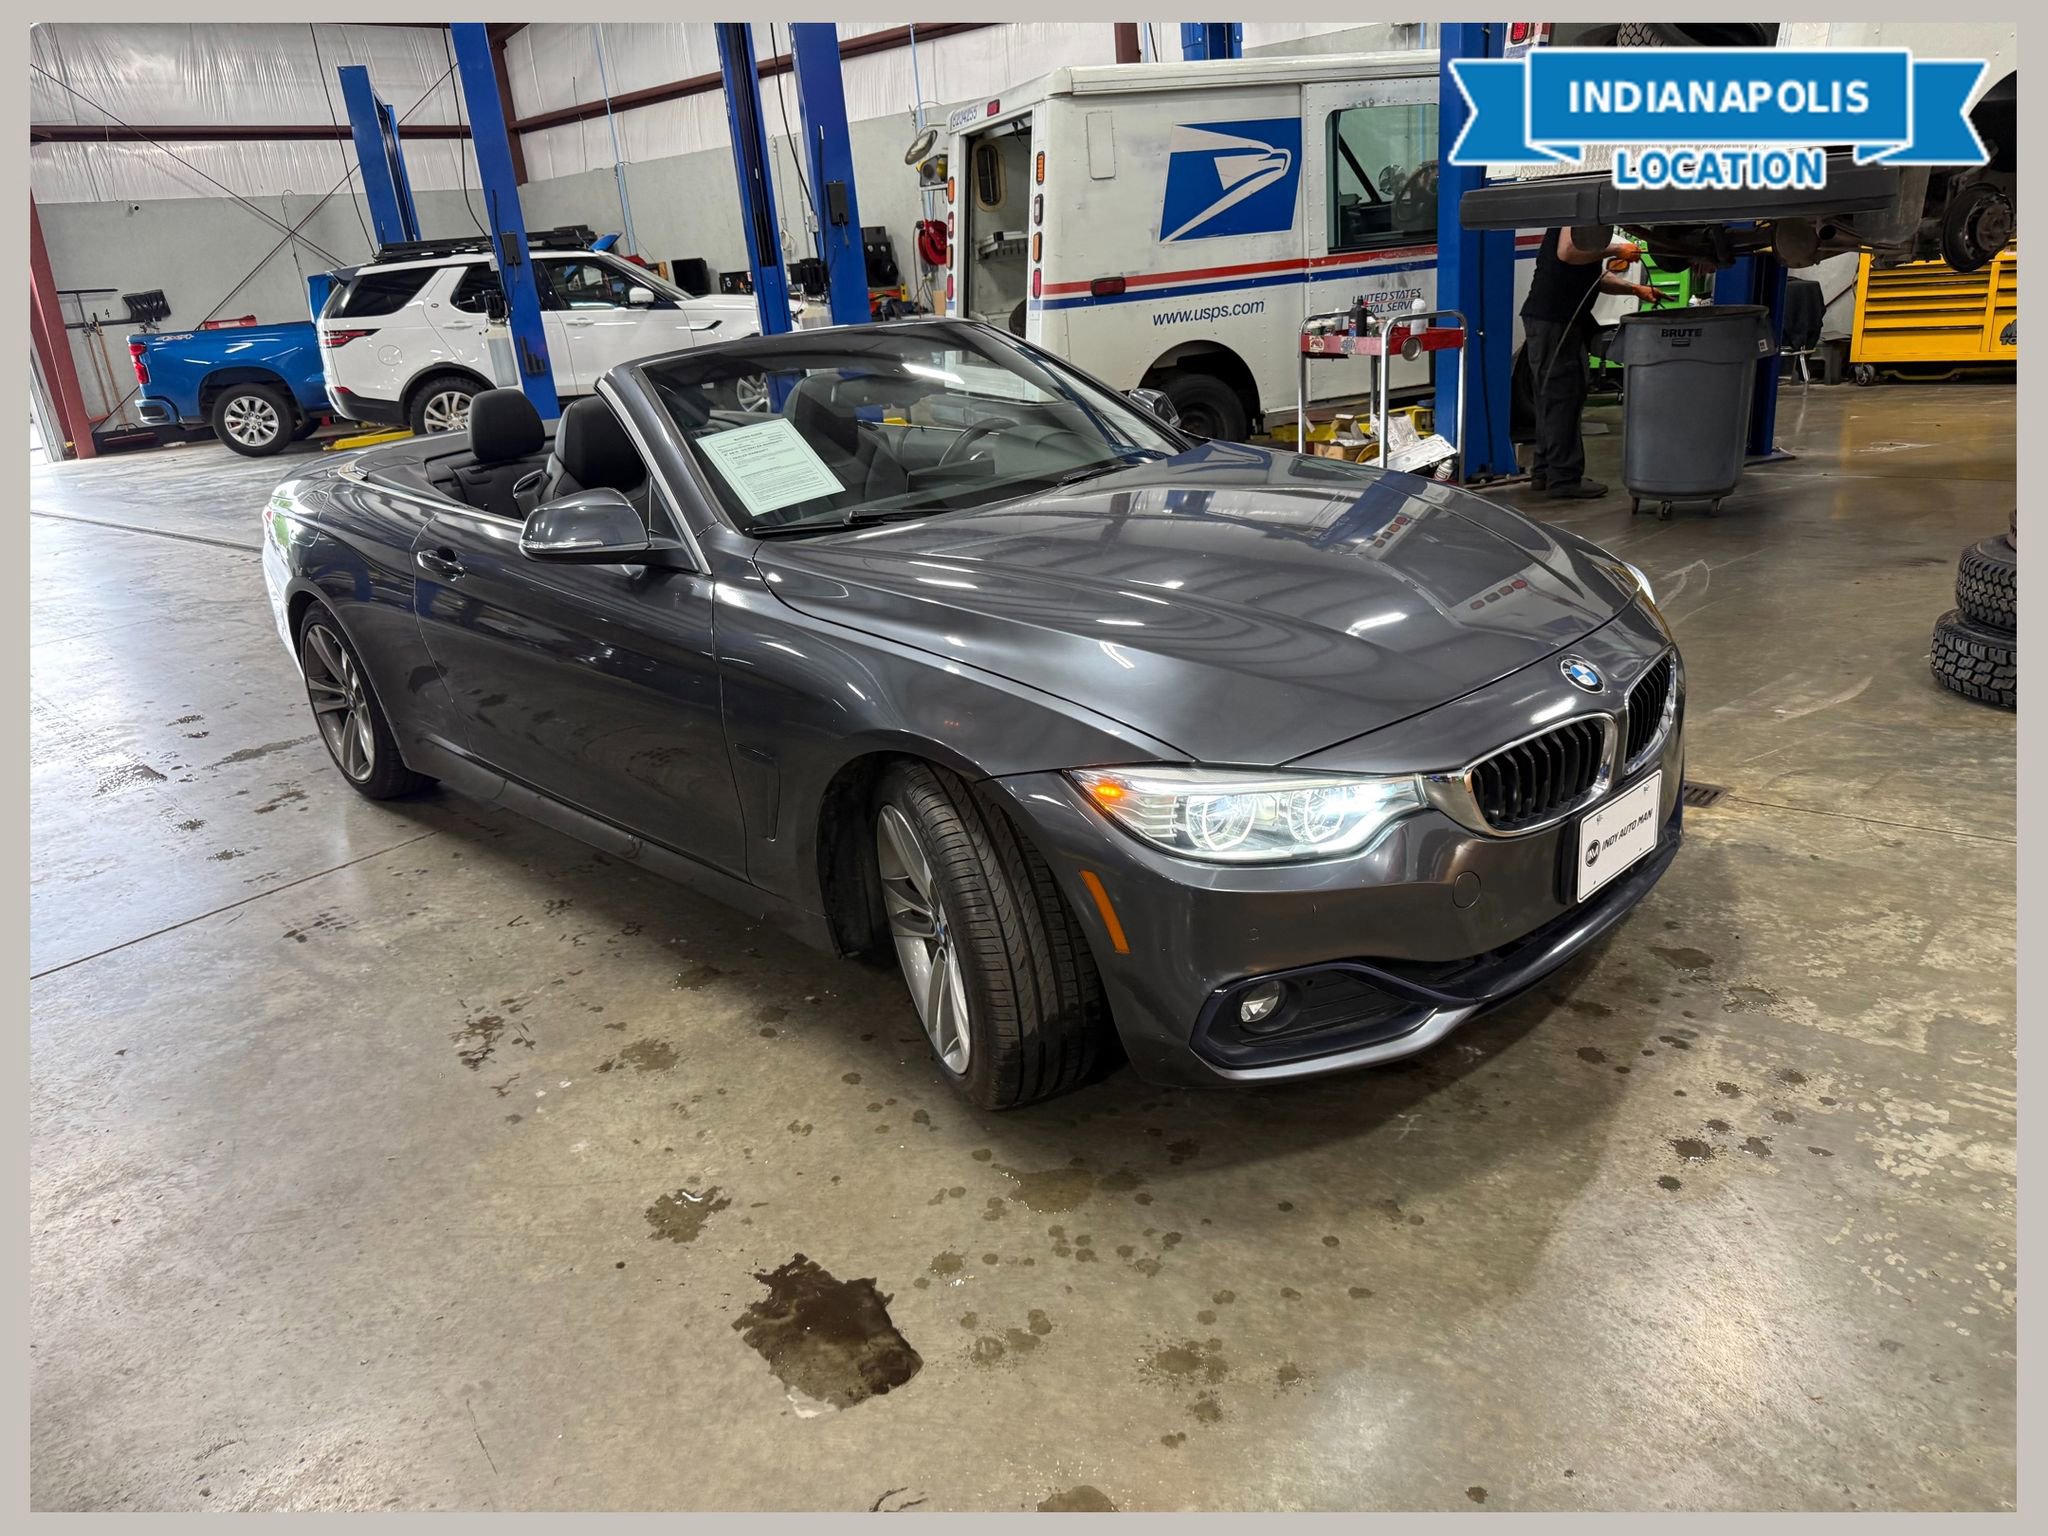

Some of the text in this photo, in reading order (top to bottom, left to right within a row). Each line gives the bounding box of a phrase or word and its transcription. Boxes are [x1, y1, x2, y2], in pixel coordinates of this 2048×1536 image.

[1389, 287, 1422, 301] STATES
[104, 307, 111, 319] 4
[1152, 300, 1265, 326] www.usps.com
[1661, 328, 1703, 338] BRUTE
[1601, 807, 1654, 852] INDY AUTO MAN
